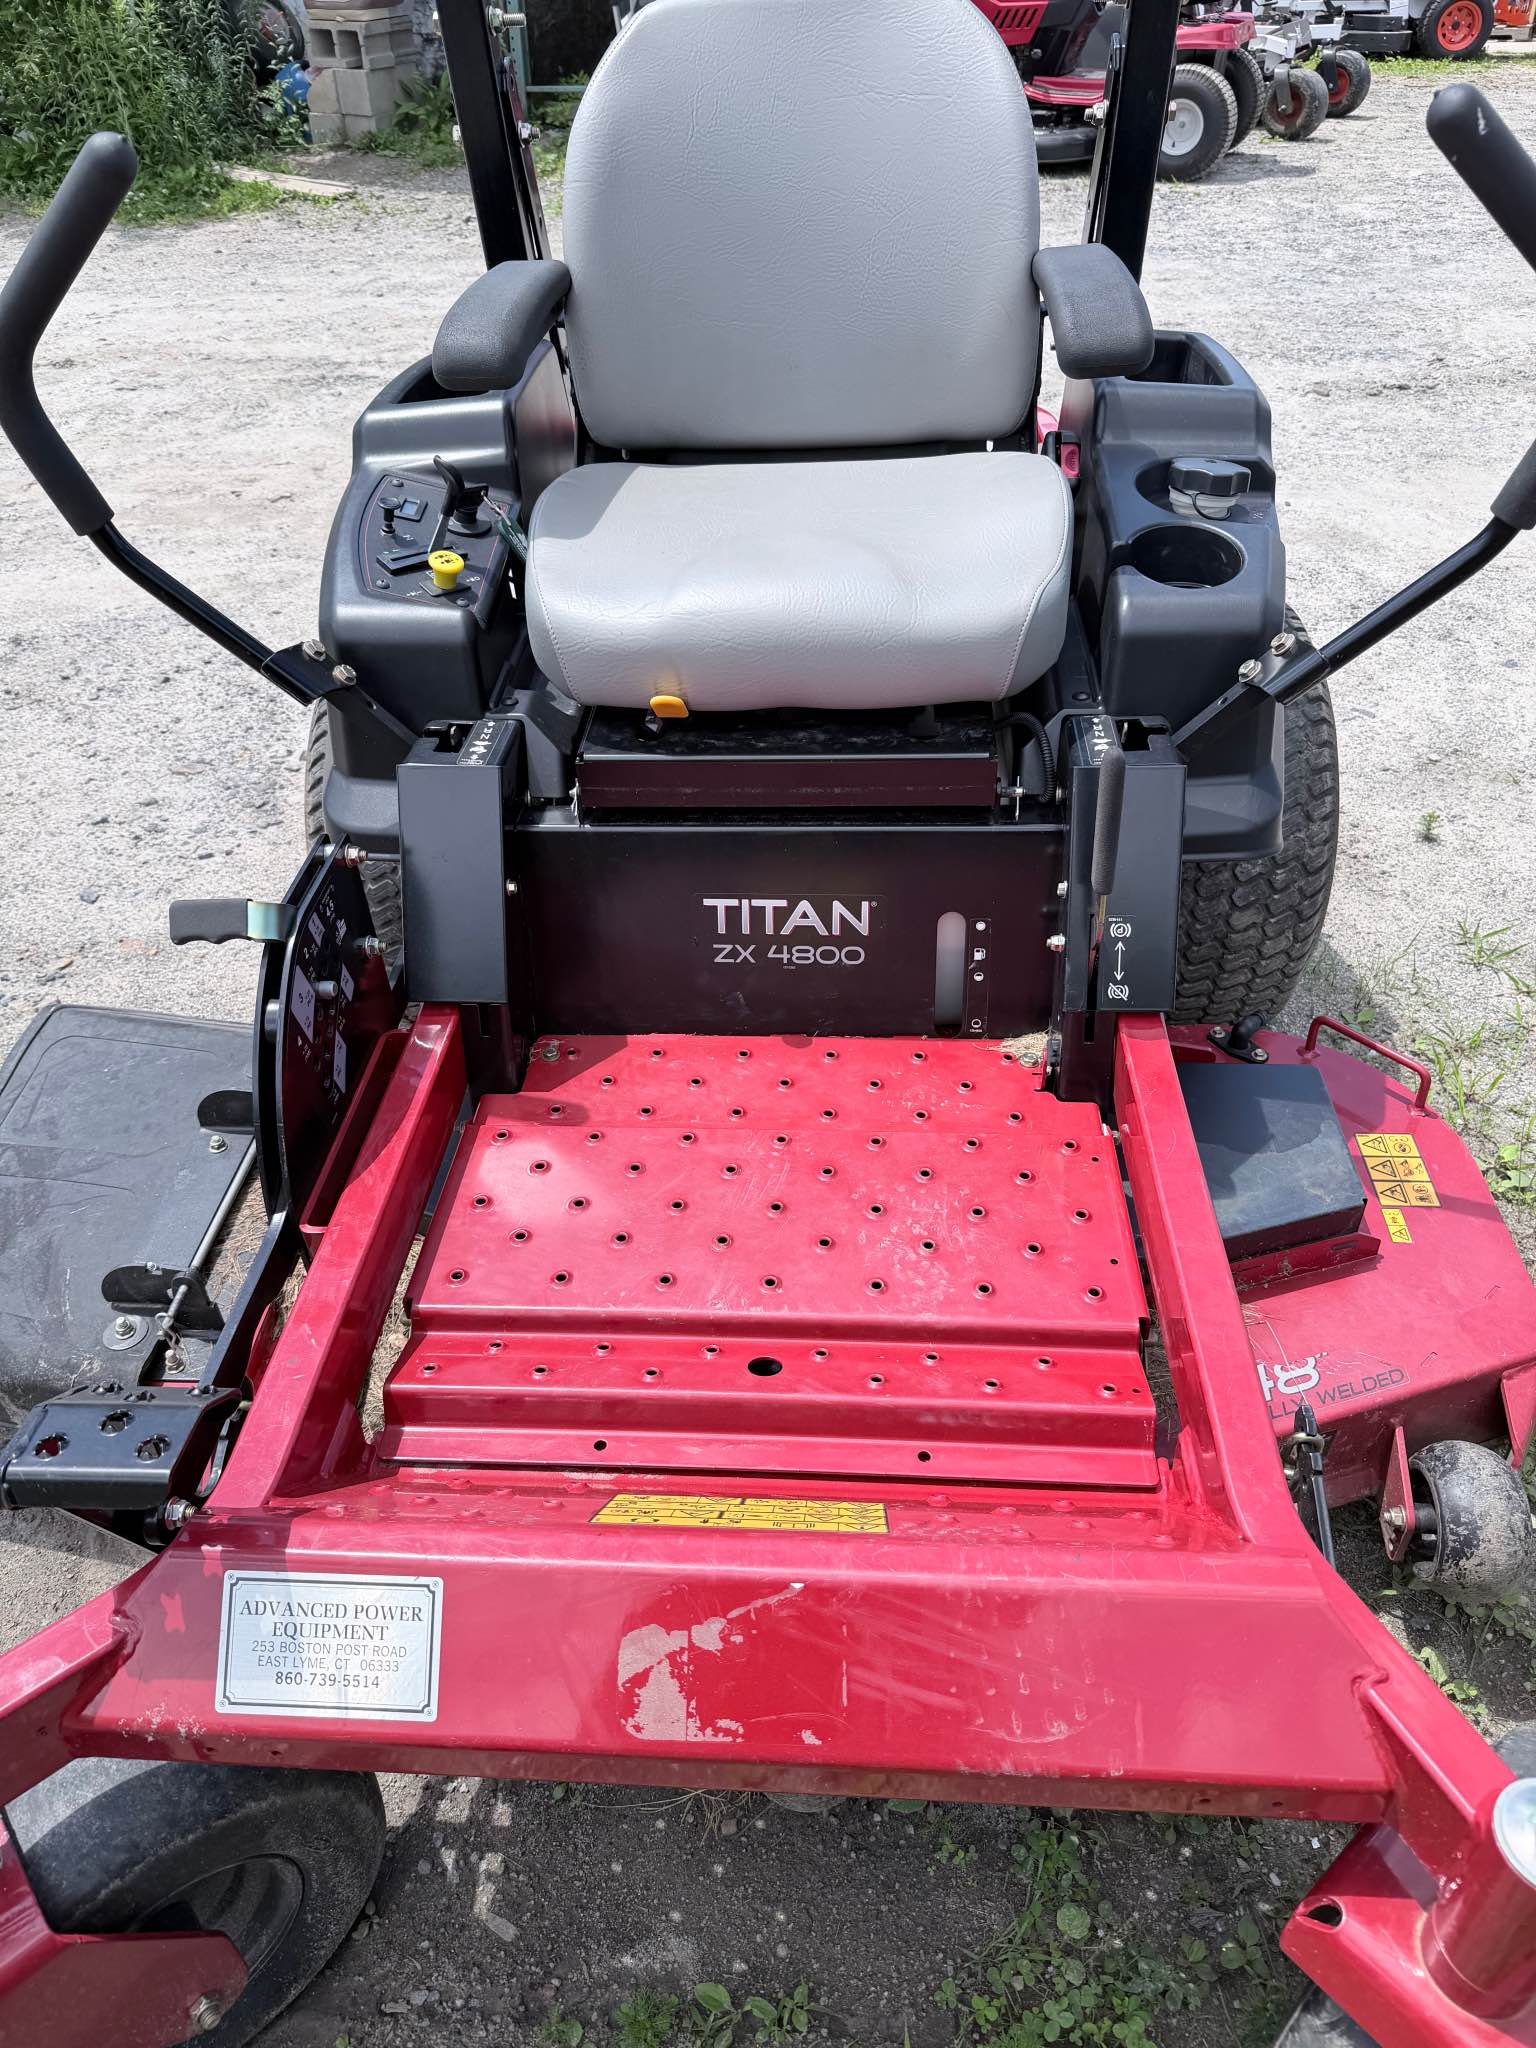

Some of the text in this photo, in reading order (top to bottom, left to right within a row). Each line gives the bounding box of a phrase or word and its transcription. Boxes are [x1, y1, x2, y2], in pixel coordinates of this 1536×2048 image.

[712, 943, 866, 965] ZX 4800
[1315, 1368, 1406, 1405] WELDED
[240, 1599, 424, 1622] ADVANCED POWER
[271, 1621, 389, 1641] EQUIPMENT
[251, 1640, 407, 1658] 253 BOSTON POST ROAD
[257, 1655, 400, 1672] EAST LYME, CT 06333
[274, 1671, 381, 1689] 860-739-5514
